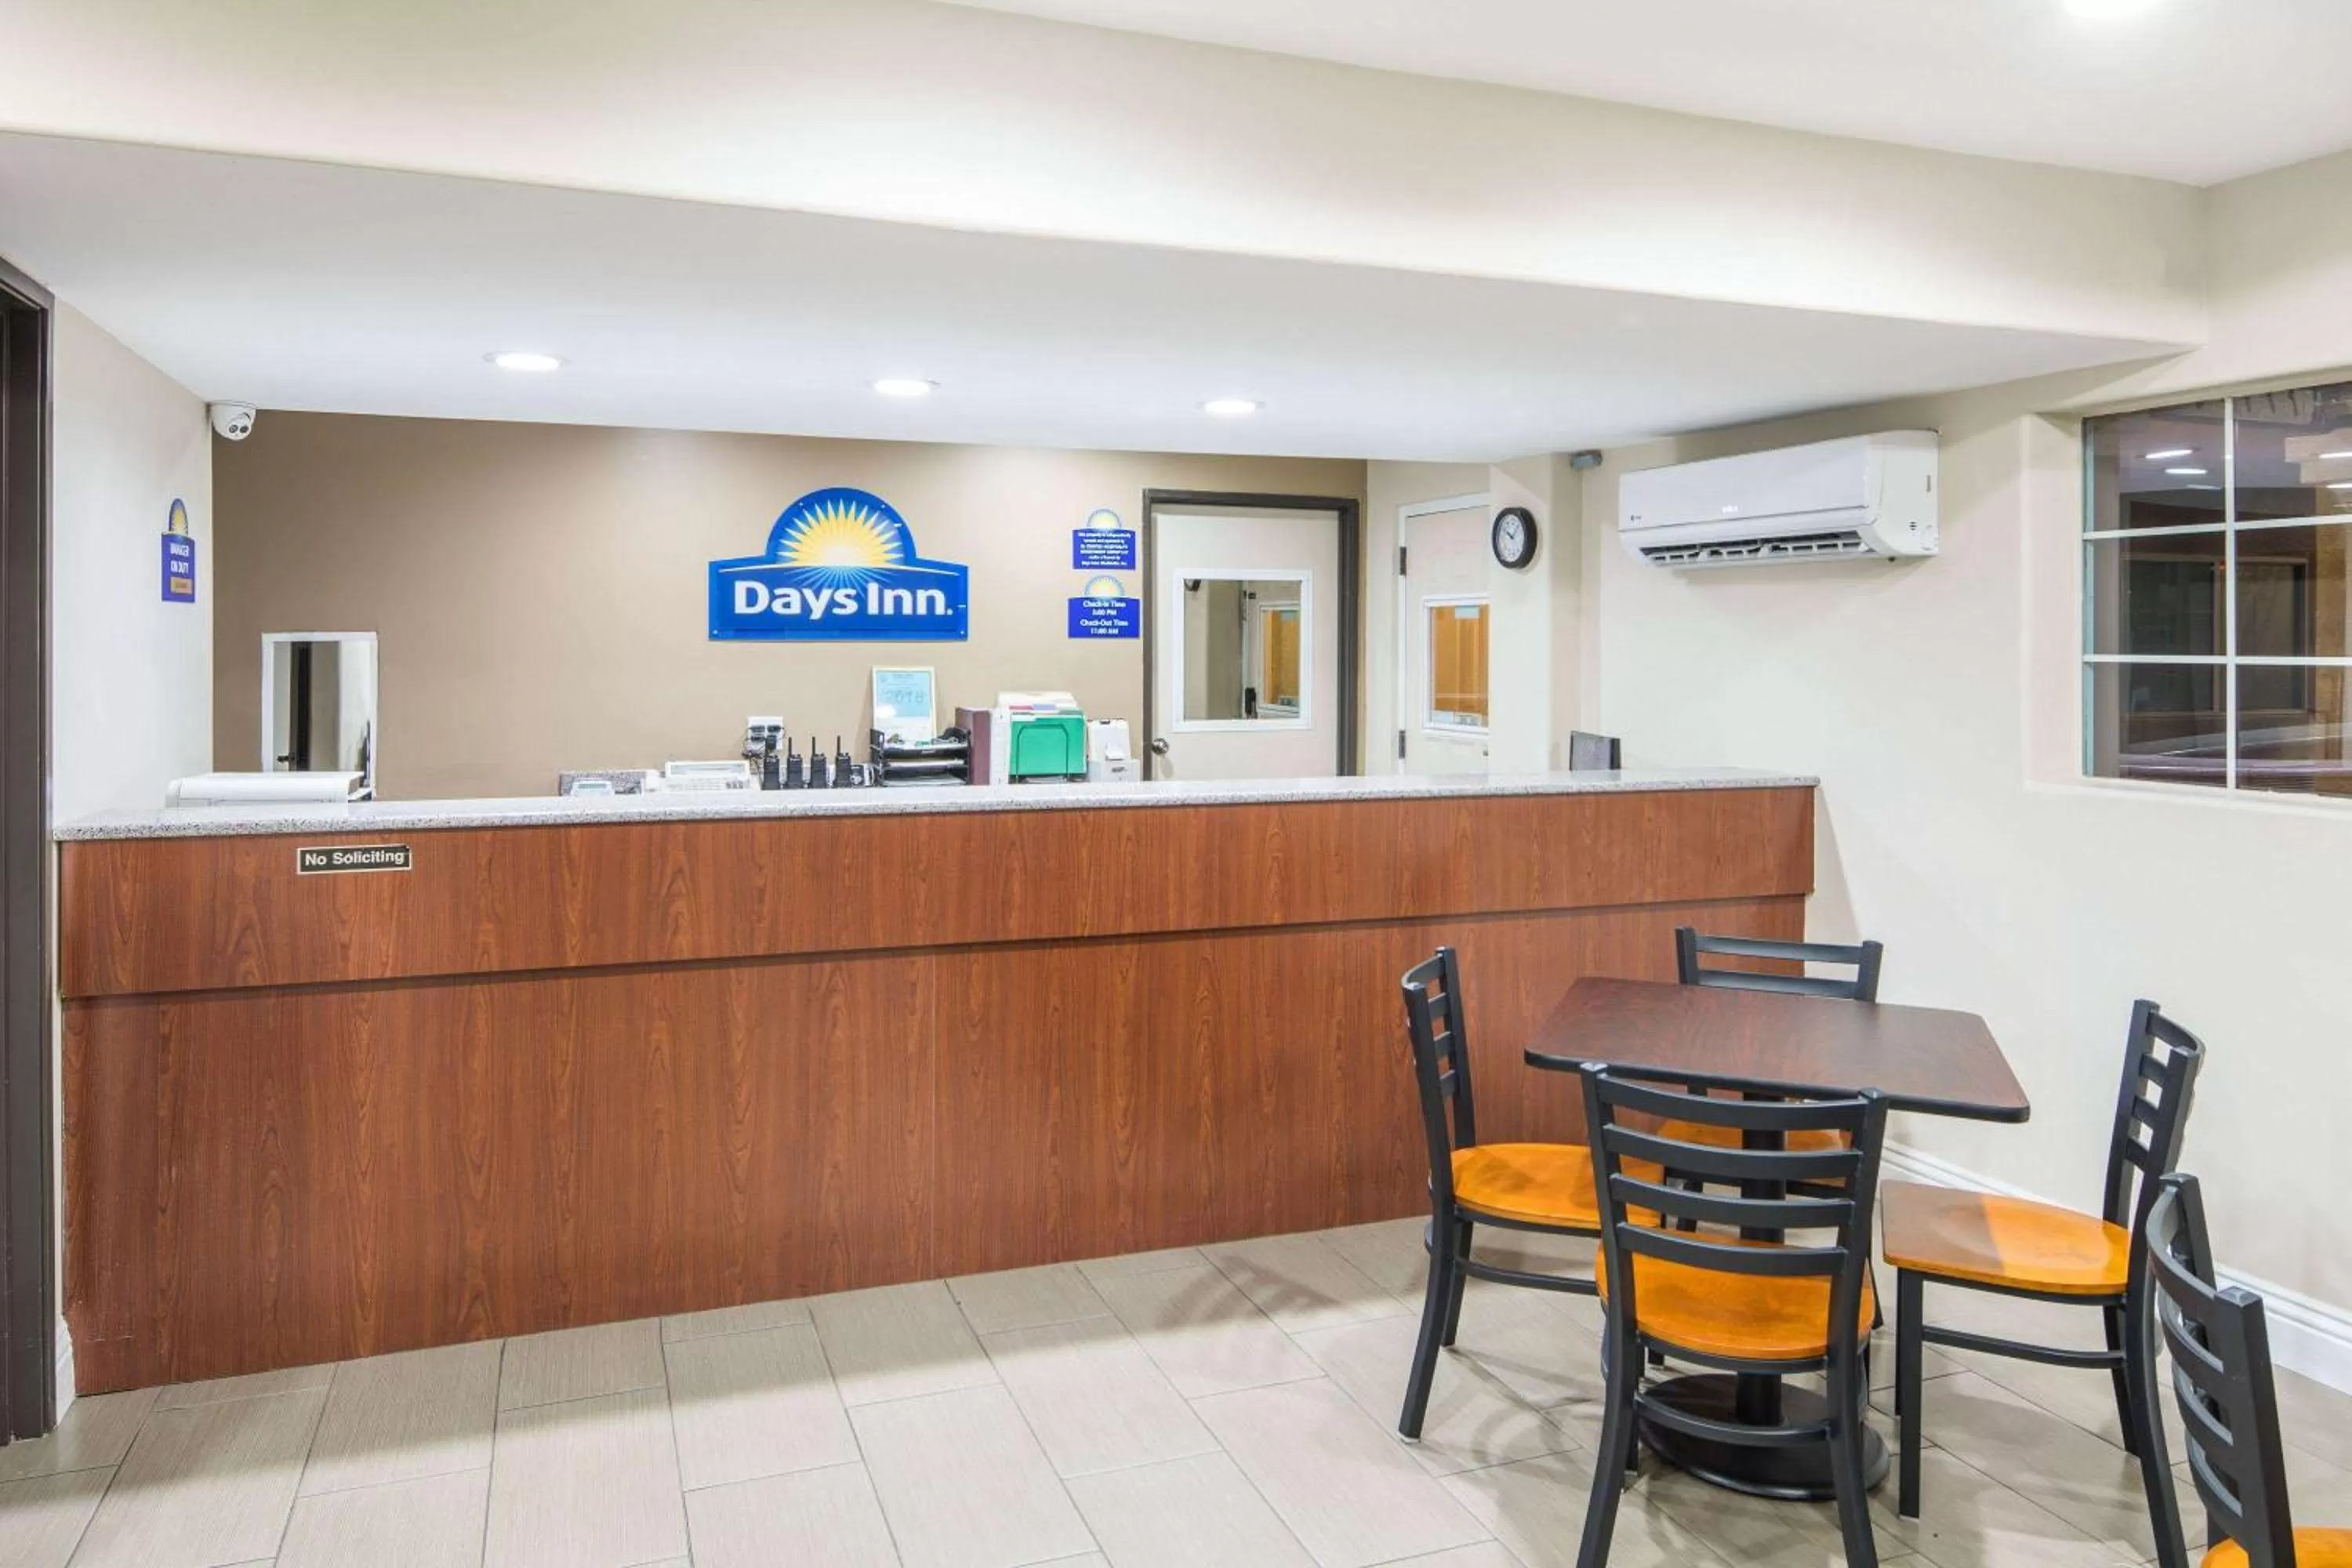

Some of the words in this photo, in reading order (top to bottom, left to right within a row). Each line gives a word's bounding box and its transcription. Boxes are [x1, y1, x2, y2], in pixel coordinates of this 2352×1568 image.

[734, 580, 858, 620] Days
[867, 583, 953, 615] Inn.
[305, 853, 327, 866] No
[332, 850, 405, 865] Soliciting
